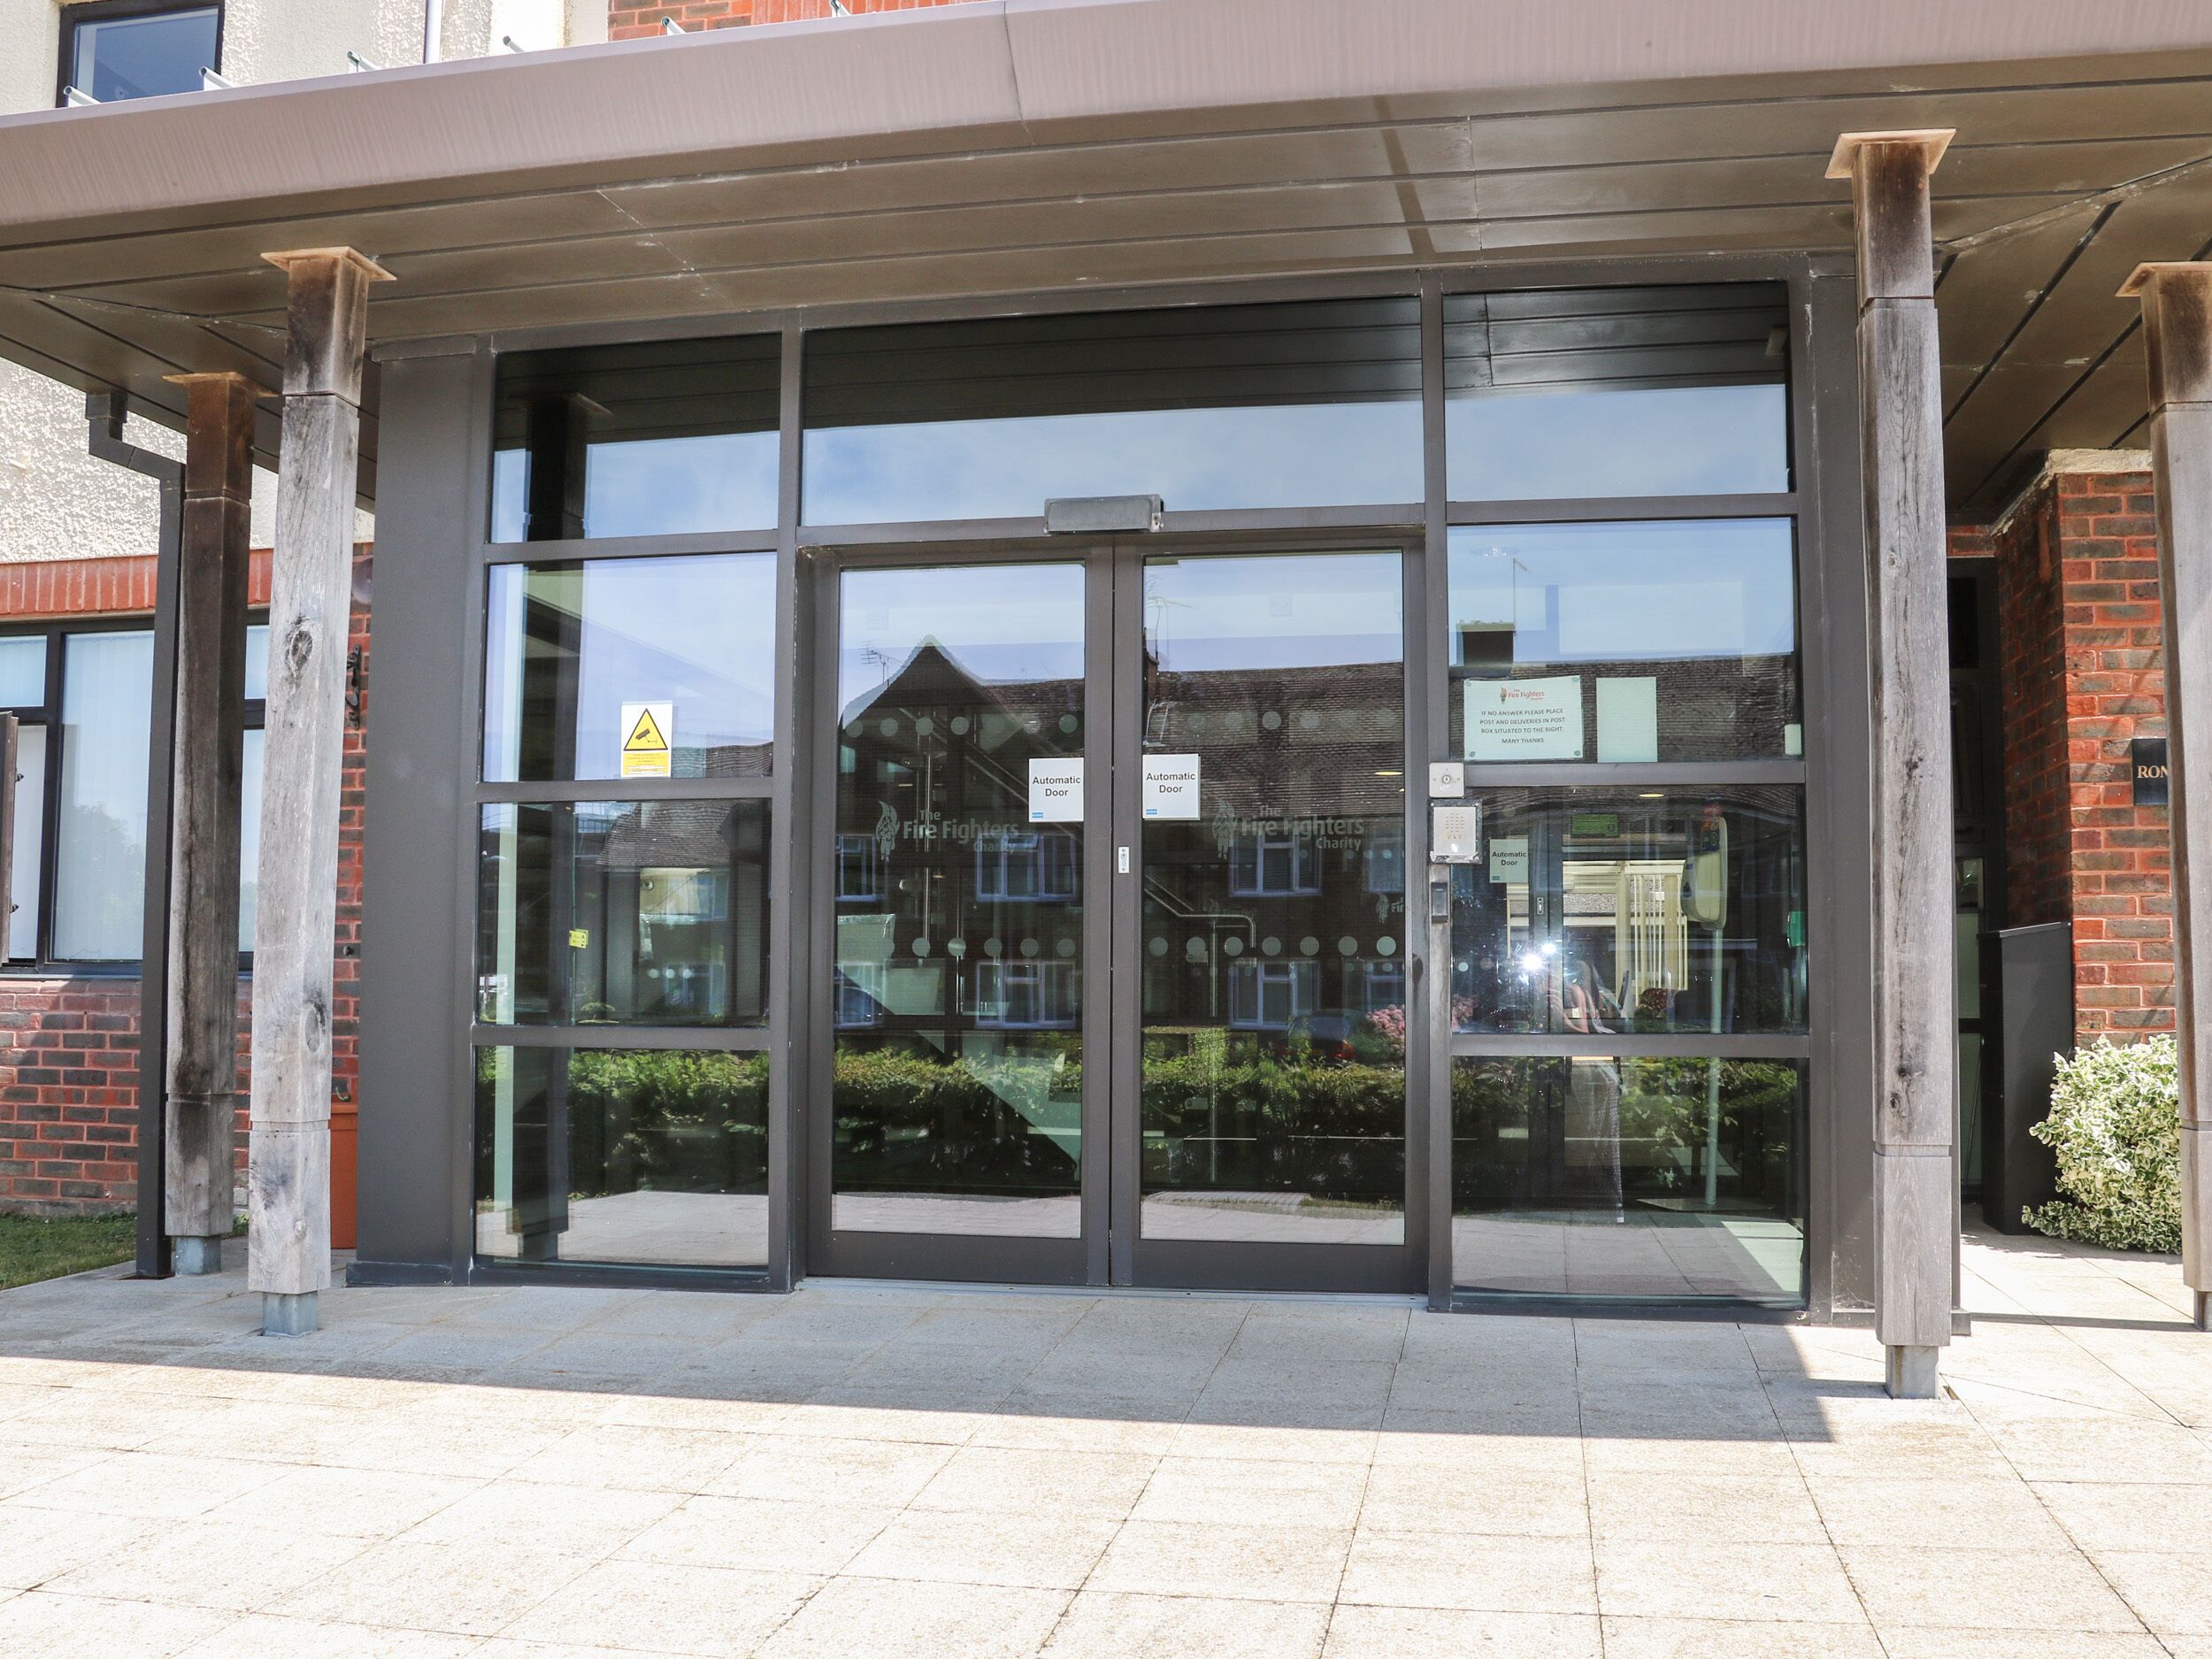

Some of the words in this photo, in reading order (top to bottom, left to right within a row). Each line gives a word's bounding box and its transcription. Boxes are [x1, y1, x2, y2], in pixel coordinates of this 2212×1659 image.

[1520, 690, 1545, 700] Fighters
[1032, 775, 1081, 785] Automatic
[1146, 772, 1195, 781] Automatic
[1045, 787, 1069, 797] Door
[1158, 784, 1183, 794] Door
[919, 810, 941, 821] The
[1259, 804, 1282, 818] The
[902, 818, 937, 840] Fire
[942, 818, 1019, 844] Fighters
[1241, 816, 1279, 836] Fire
[1283, 814, 1365, 841] Fighters
[973, 840, 1017, 854] Charity
[1316, 836, 1362, 851] Charity
